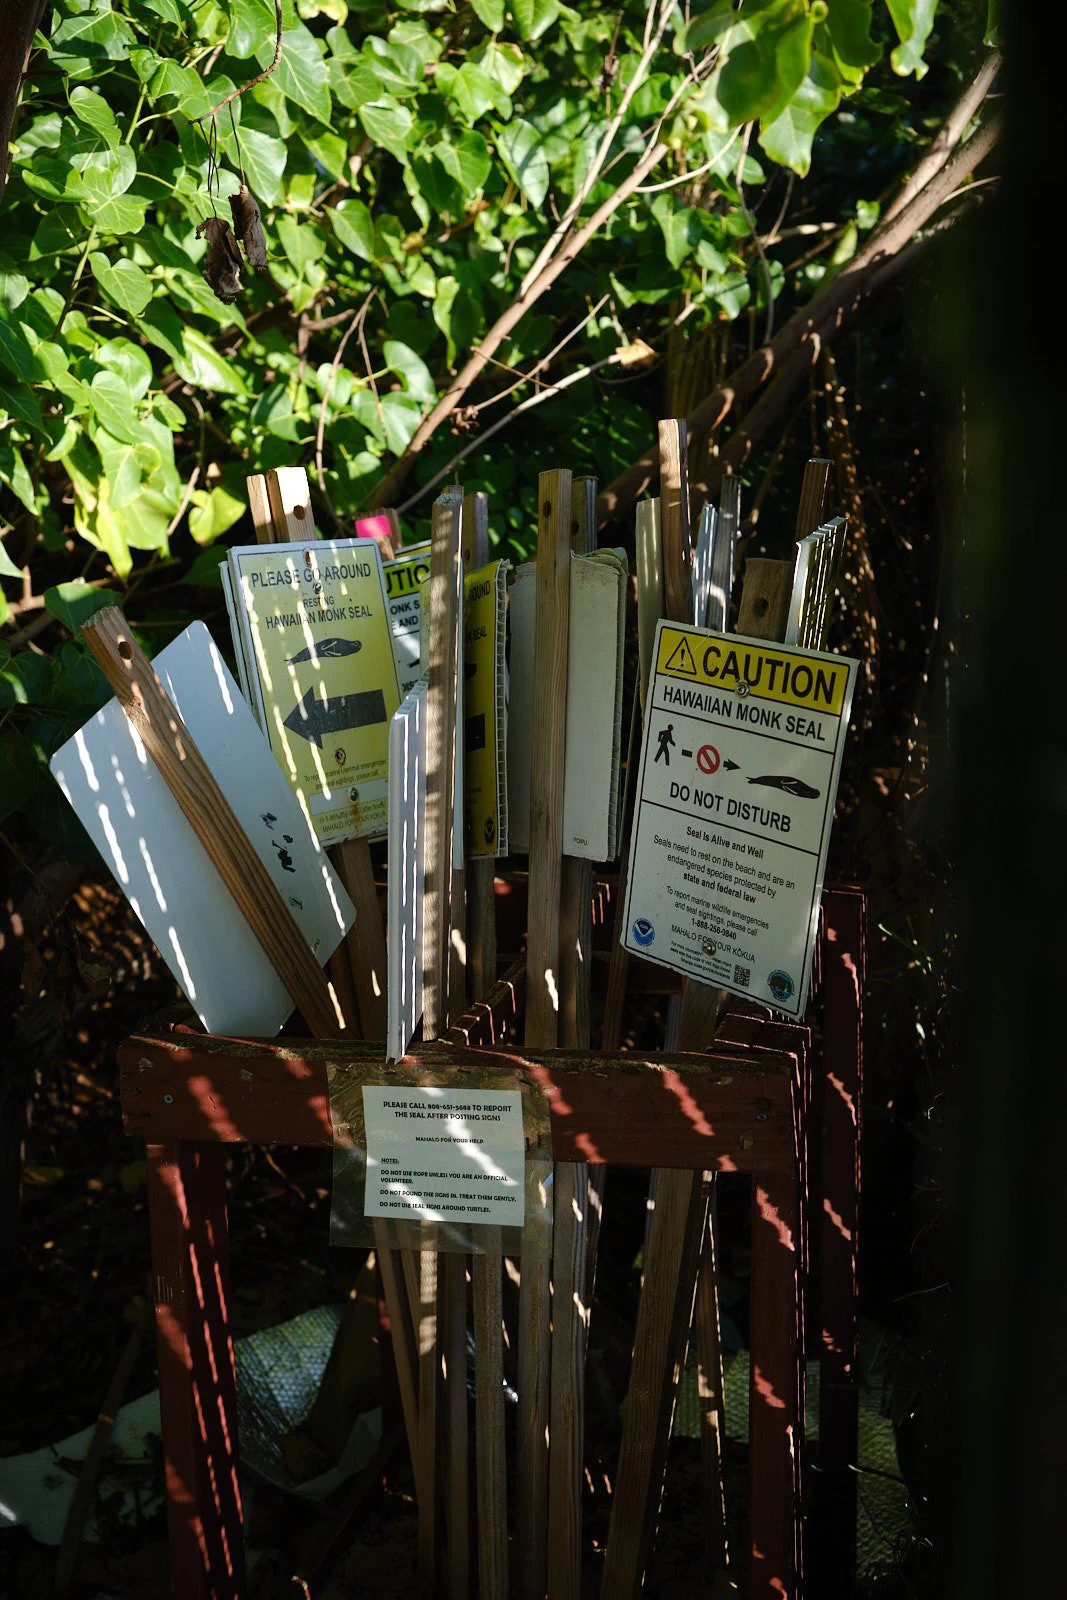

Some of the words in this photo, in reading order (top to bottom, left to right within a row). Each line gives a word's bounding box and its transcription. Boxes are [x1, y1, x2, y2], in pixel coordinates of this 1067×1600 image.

[251, 569, 301, 587] PLEASE
[304, 568, 320, 582] GO
[325, 563, 371, 581] AROUND
[318, 608, 347, 622] MONK
[349, 606, 372, 618] SEAL
[390, 602, 411, 615] ONK
[399, 616, 418, 627] AND
[703, 646, 836, 704] CAUTION
[664, 686, 732, 717] HAWAIIAN
[736, 703, 781, 729] MONK
[786, 716, 825, 741] SEAL
[670, 782, 690, 801] DO
[694, 789, 723, 811] NOT
[727, 799, 791, 832] DISTURB
[687, 826, 701, 839] Seal
[703, 832, 709, 841] Is
[711, 835, 730, 847] Alive
[732, 843, 746, 852] and
[748, 845, 764, 858] Well
[654, 835, 671, 848] Seals
[673, 842, 689, 854] need
[691, 848, 696, 856] to
[698, 851, 711, 861] rest
[712, 856, 721, 864] on
[723, 858, 734, 868] the
[735, 862, 756, 876] beach
[758, 871, 771, 881] and
[773, 876, 784, 886] are
[786, 881, 795, 889] an
[668, 855, 705, 873] endangered
[707, 868, 732, 882] species
[734, 877, 766, 893] protected
[768, 886, 776, 899] by
[683, 873, 700, 884] state
[702, 880, 716, 890] and
[717, 883, 742, 898] federal
[743, 892, 756, 903] law
[667, 886, 673, 894] To
[674, 890, 690, 901] report
[712, 903, 731, 915] wildlife
[732, 911, 769, 929] emergencies
[675, 901, 685, 910] and
[686, 905, 697, 915] seal
[727, 920, 746, 932] please
[671, 924, 696, 940] MAHALO
